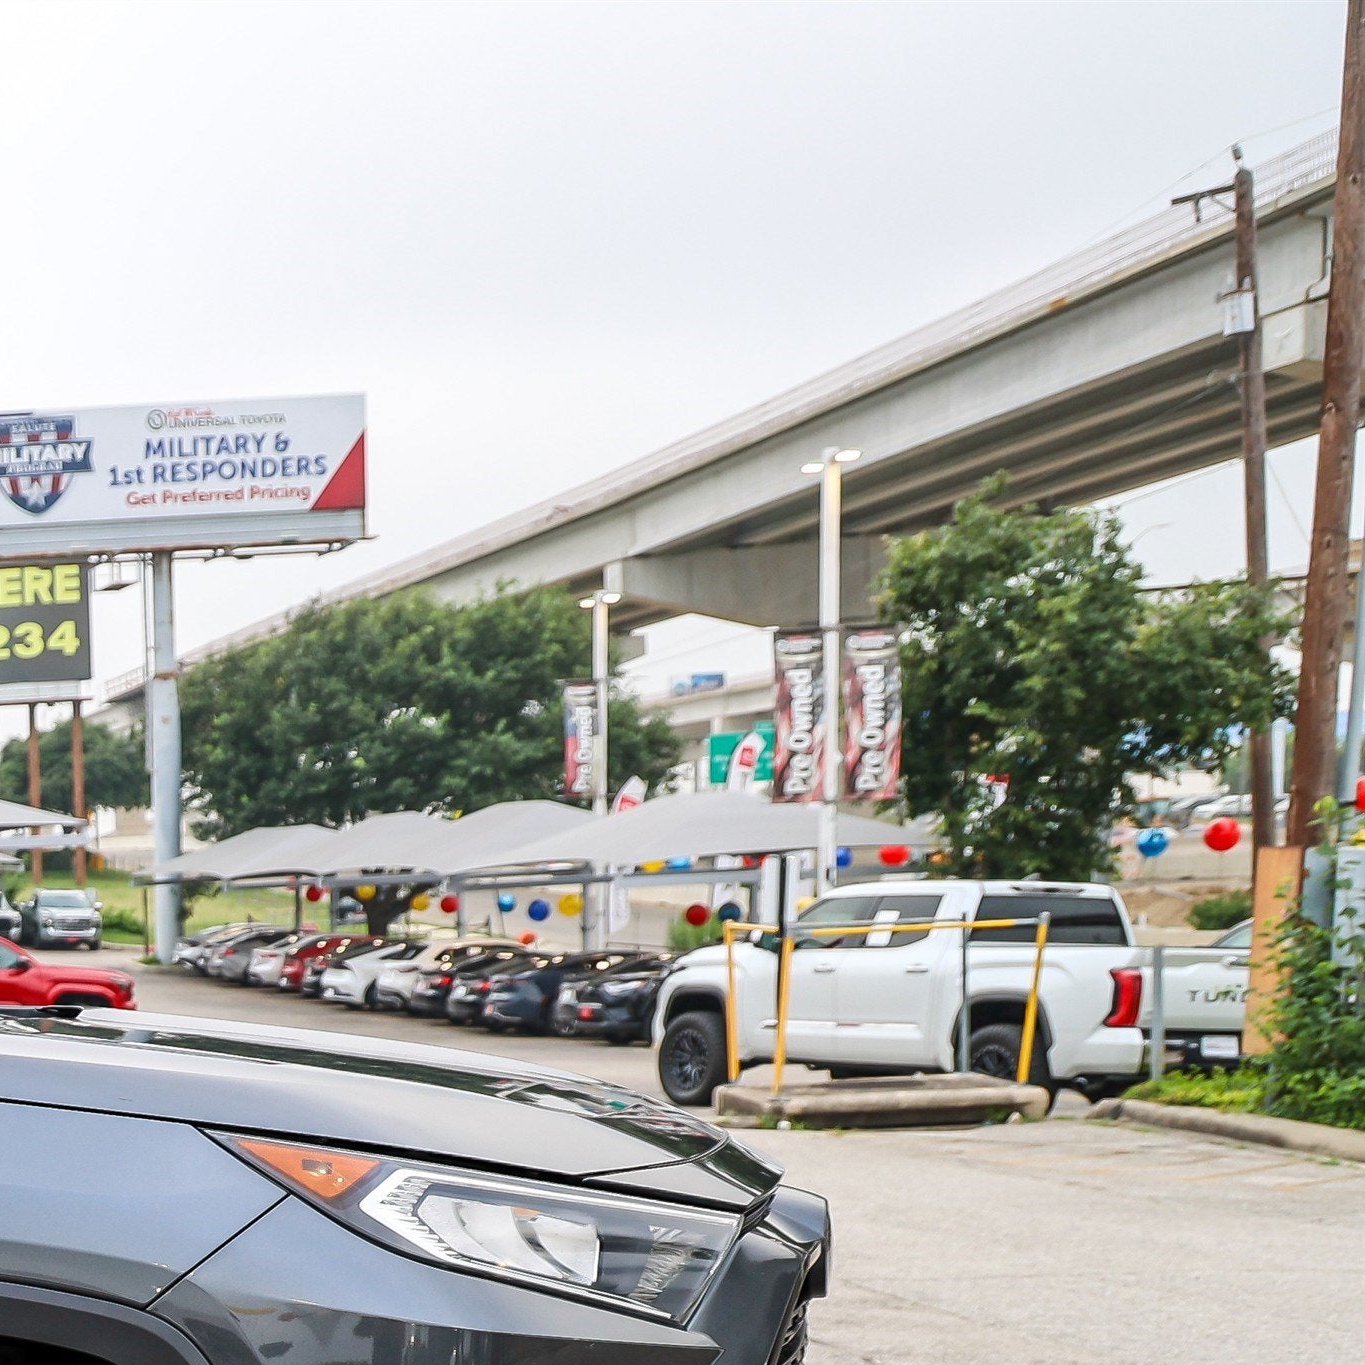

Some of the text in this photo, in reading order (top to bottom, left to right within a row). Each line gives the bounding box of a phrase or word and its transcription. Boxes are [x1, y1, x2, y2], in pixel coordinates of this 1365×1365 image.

[145, 431, 291, 459] MILITARY &
[109, 453, 329, 486] 1st RESPONDERS
[126, 484, 311, 506] Get Preferred Pricing
[784, 667, 813, 752] Owned
[856, 664, 885, 749] Owned
[783, 753, 812, 796] Pre
[855, 750, 883, 793] Pre
